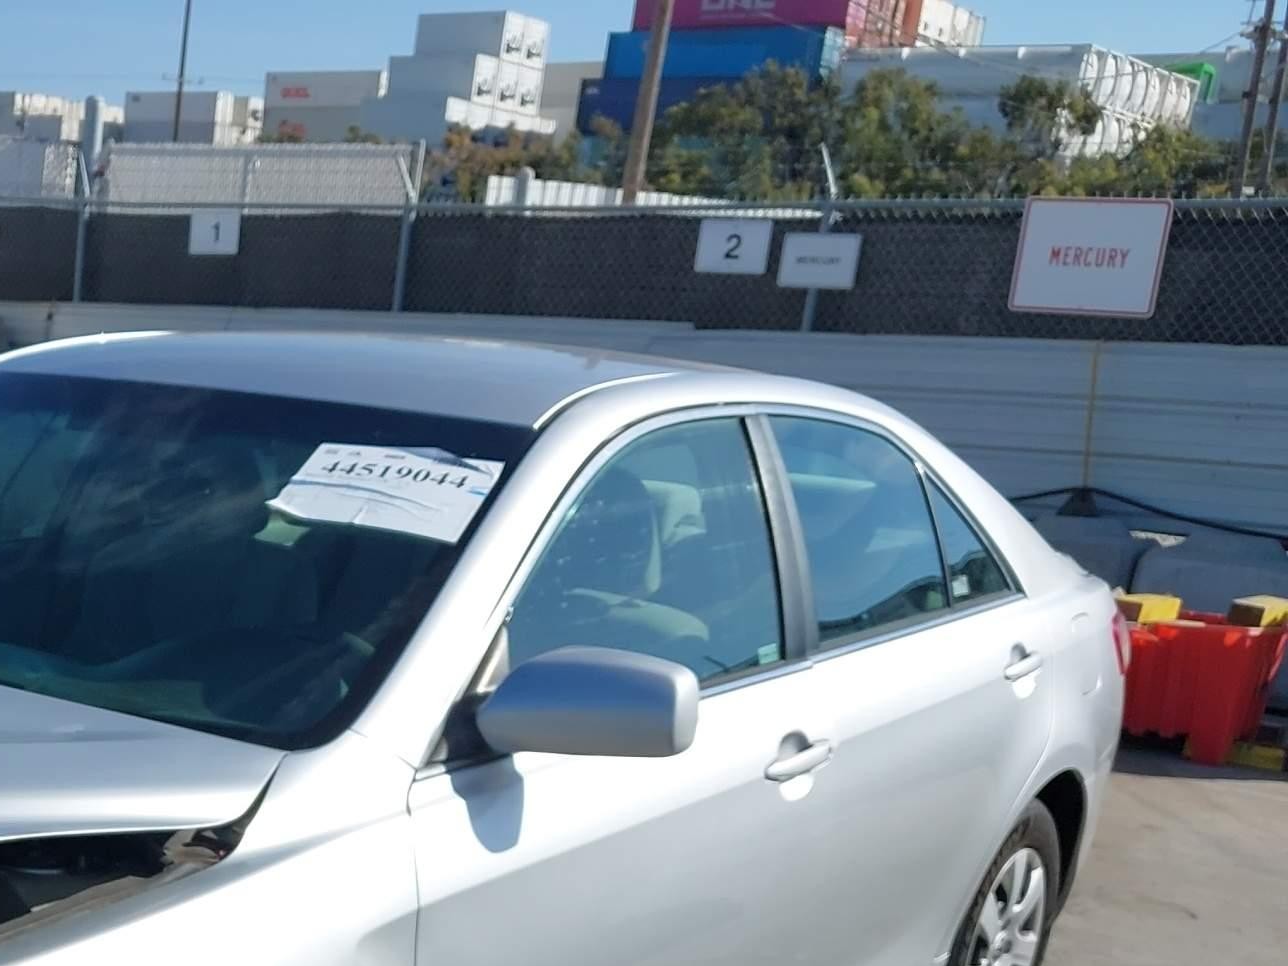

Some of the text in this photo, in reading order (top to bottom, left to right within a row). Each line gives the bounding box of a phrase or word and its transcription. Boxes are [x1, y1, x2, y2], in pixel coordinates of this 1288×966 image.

[211, 221, 221, 243] 1
[723, 233, 742, 260] 2
[1048, 245, 1130, 269] MERCURY
[321, 461, 470, 489] 44519044
